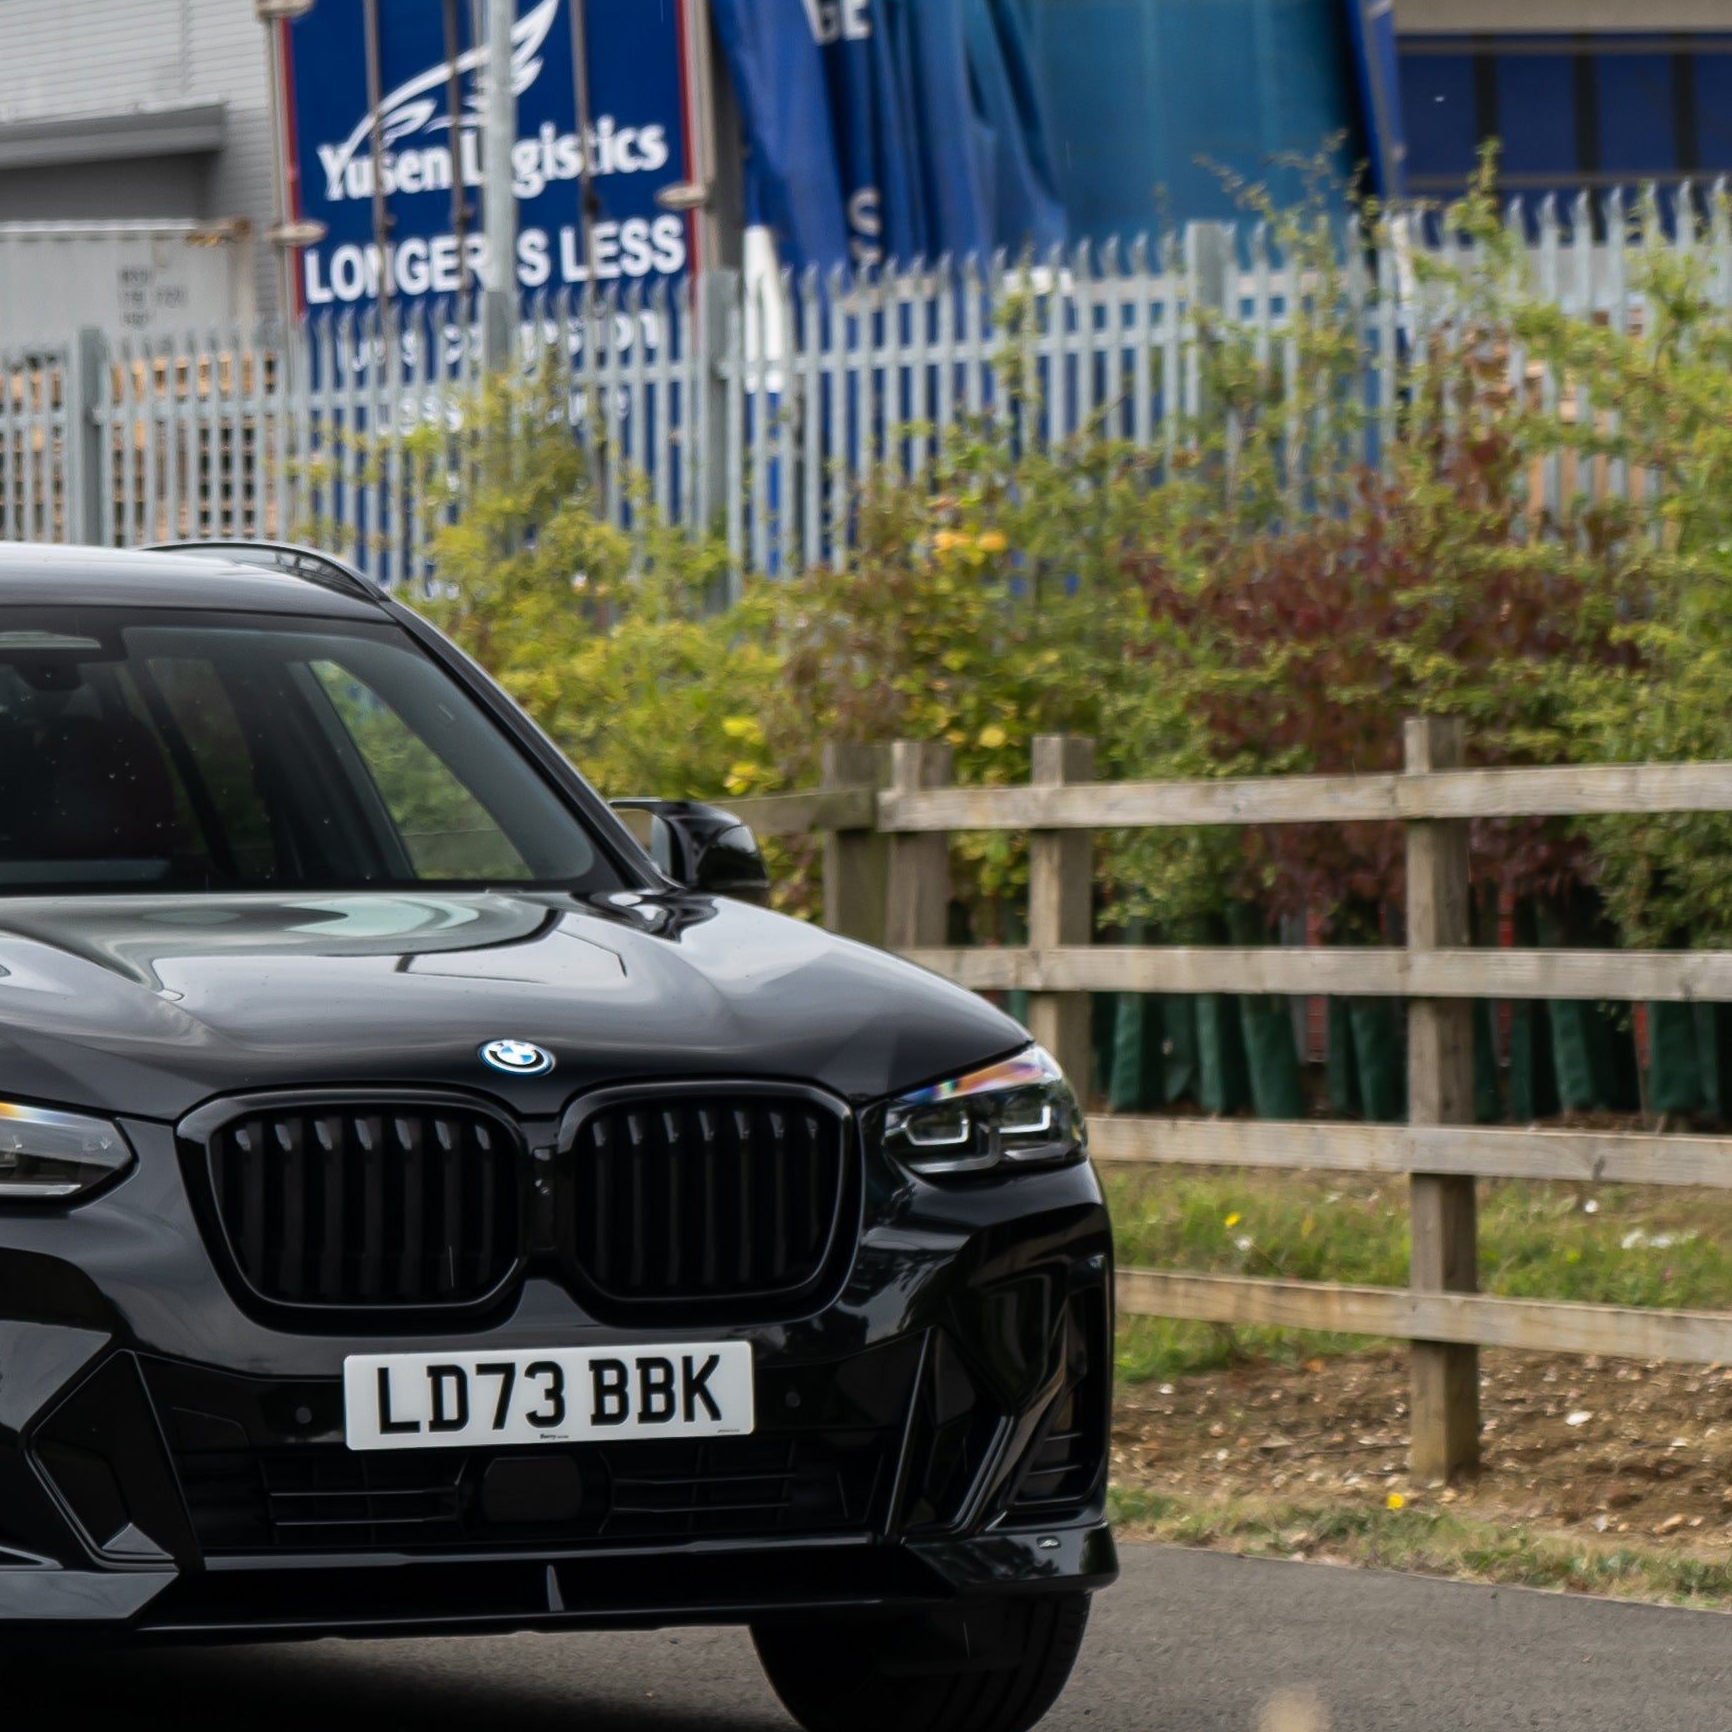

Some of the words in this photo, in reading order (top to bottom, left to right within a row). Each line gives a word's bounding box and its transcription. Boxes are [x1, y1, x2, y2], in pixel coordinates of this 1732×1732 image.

[316, 143, 452, 201] Yusen
[461, 114, 668, 199] Lgisics
[304, 232, 491, 304] LONGER
[516, 228, 552, 287] S
[559, 214, 686, 284] LESS
[376, 1359, 566, 1436] LD73
[588, 1353, 723, 1427] BBK
